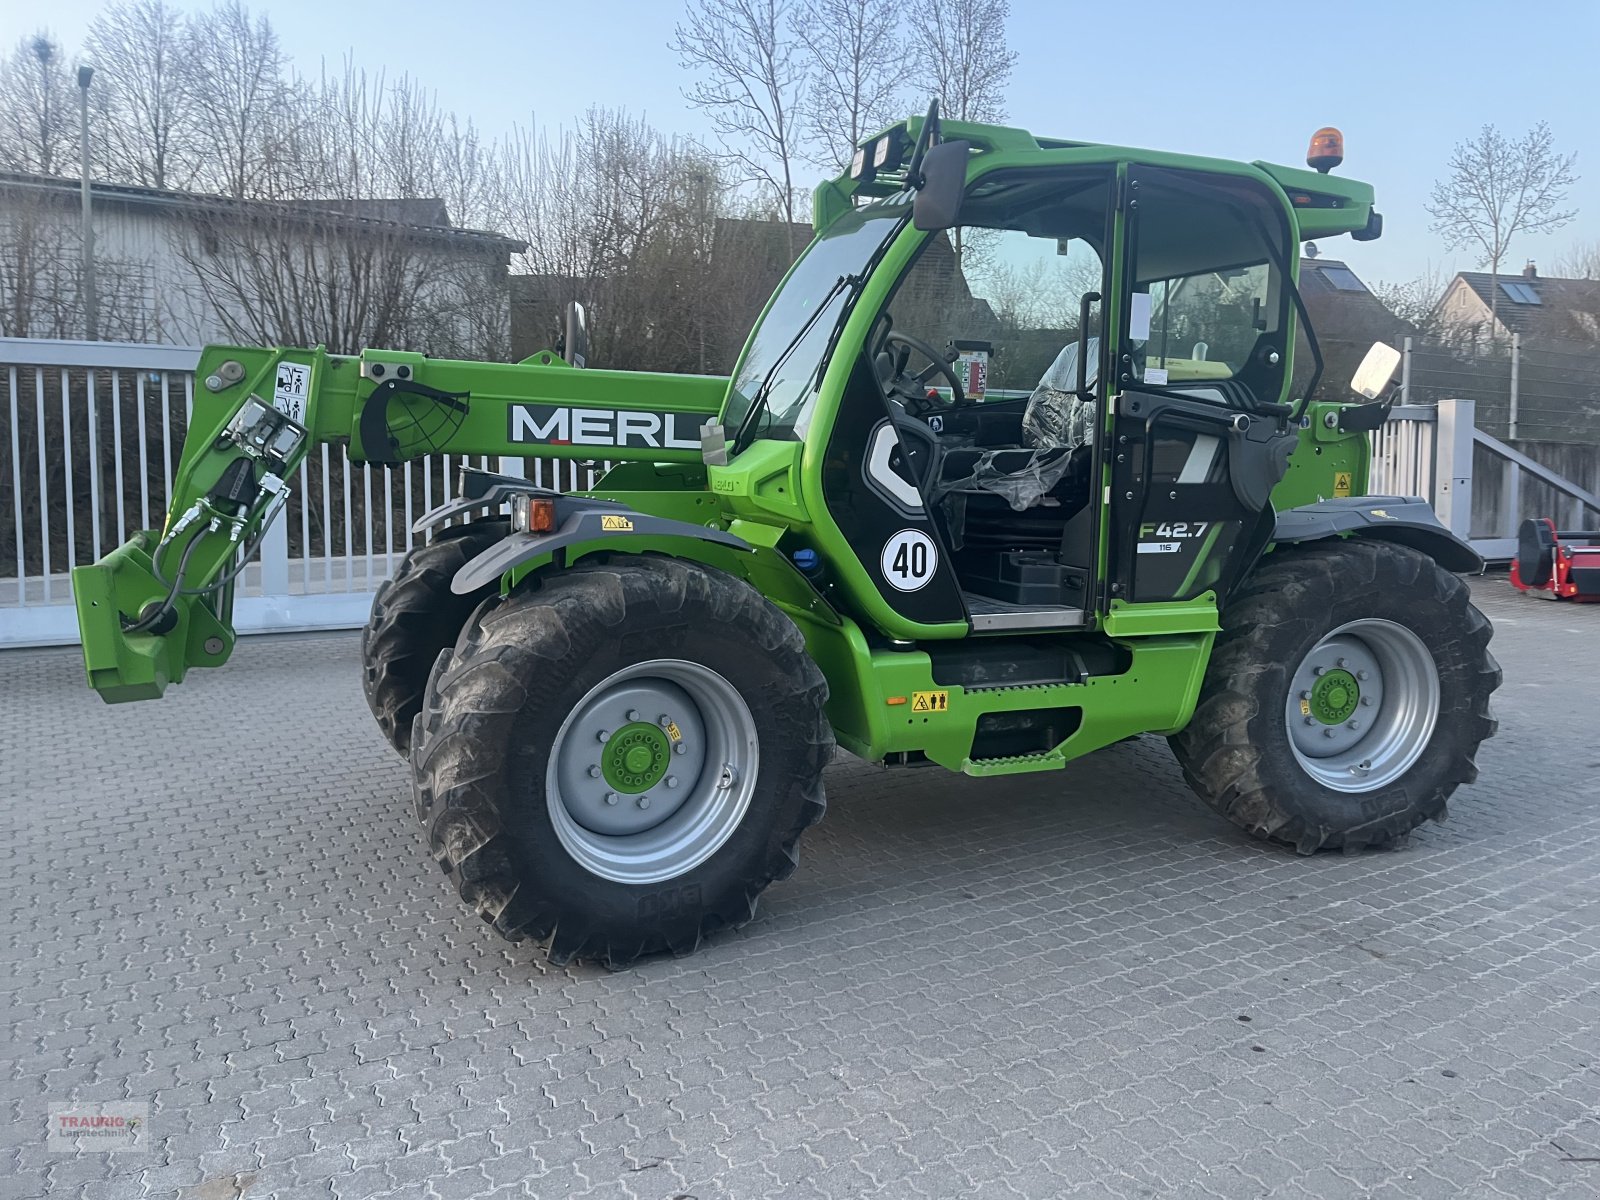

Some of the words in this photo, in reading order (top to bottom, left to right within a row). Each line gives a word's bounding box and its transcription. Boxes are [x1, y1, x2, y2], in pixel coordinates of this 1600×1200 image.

[512, 405, 718, 449] MERL
[1139, 521, 1209, 539] F42.7
[892, 541, 927, 579] 40
